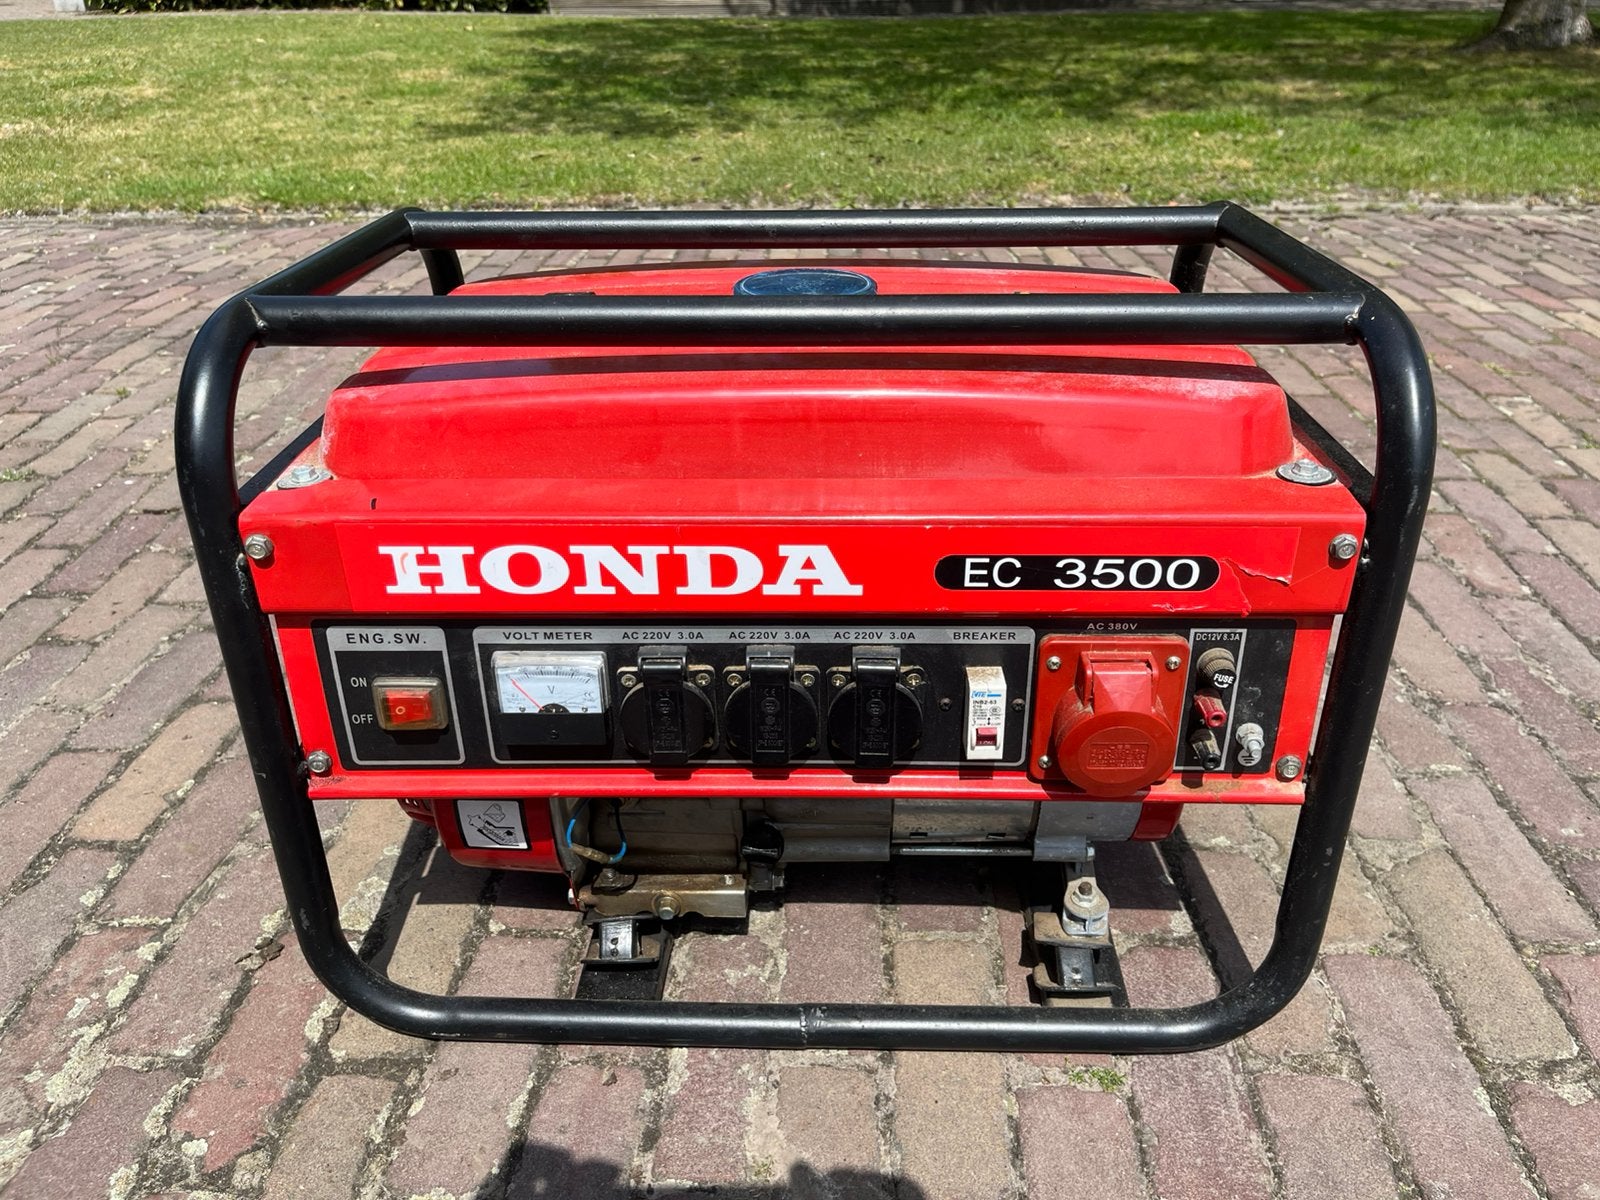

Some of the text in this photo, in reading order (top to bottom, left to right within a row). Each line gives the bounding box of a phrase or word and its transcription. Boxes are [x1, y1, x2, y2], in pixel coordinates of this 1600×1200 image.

[378, 545, 864, 596] HONDA
[963, 557, 1201, 589] EC 3500
[1086, 622, 1138, 631] AC 380V
[502, 631, 593, 641] VOLT METER
[622, 631, 704, 640] AC 220V 3.0A
[728, 631, 811, 640] AC 220V 3.0A
[833, 631, 916, 640] AC 220V 3.0A
[953, 632, 1017, 641] BREAKER
[350, 676, 368, 688] ON
[1213, 673, 1235, 685] FUSE
[547, 685, 555, 695] V
[351, 714, 374, 725] OFF
